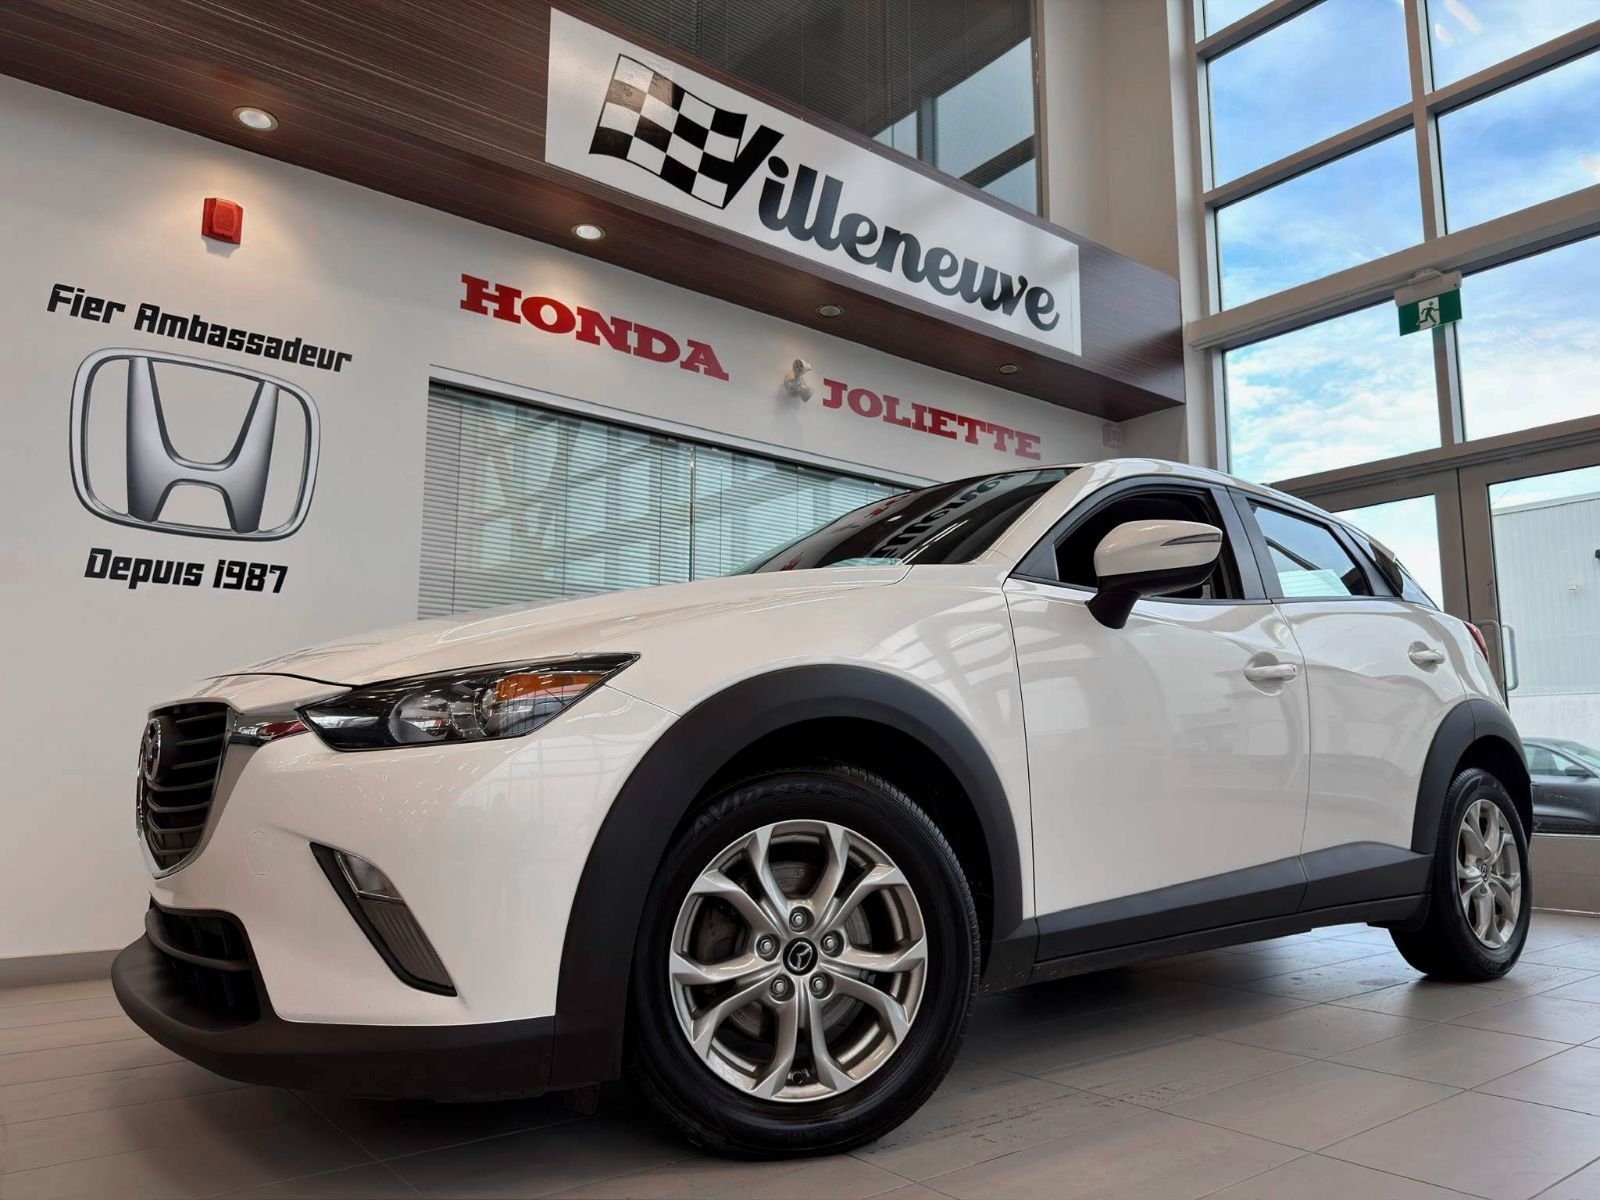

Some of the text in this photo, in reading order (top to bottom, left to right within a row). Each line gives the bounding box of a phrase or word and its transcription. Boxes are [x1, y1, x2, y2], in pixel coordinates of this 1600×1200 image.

[722, 114, 1060, 332] Villeneuve
[46, 283, 353, 373] Fier Ambassadeur
[460, 273, 1041, 461] HONDA JOLIETTE
[84, 547, 289, 594] Depuis 1987
